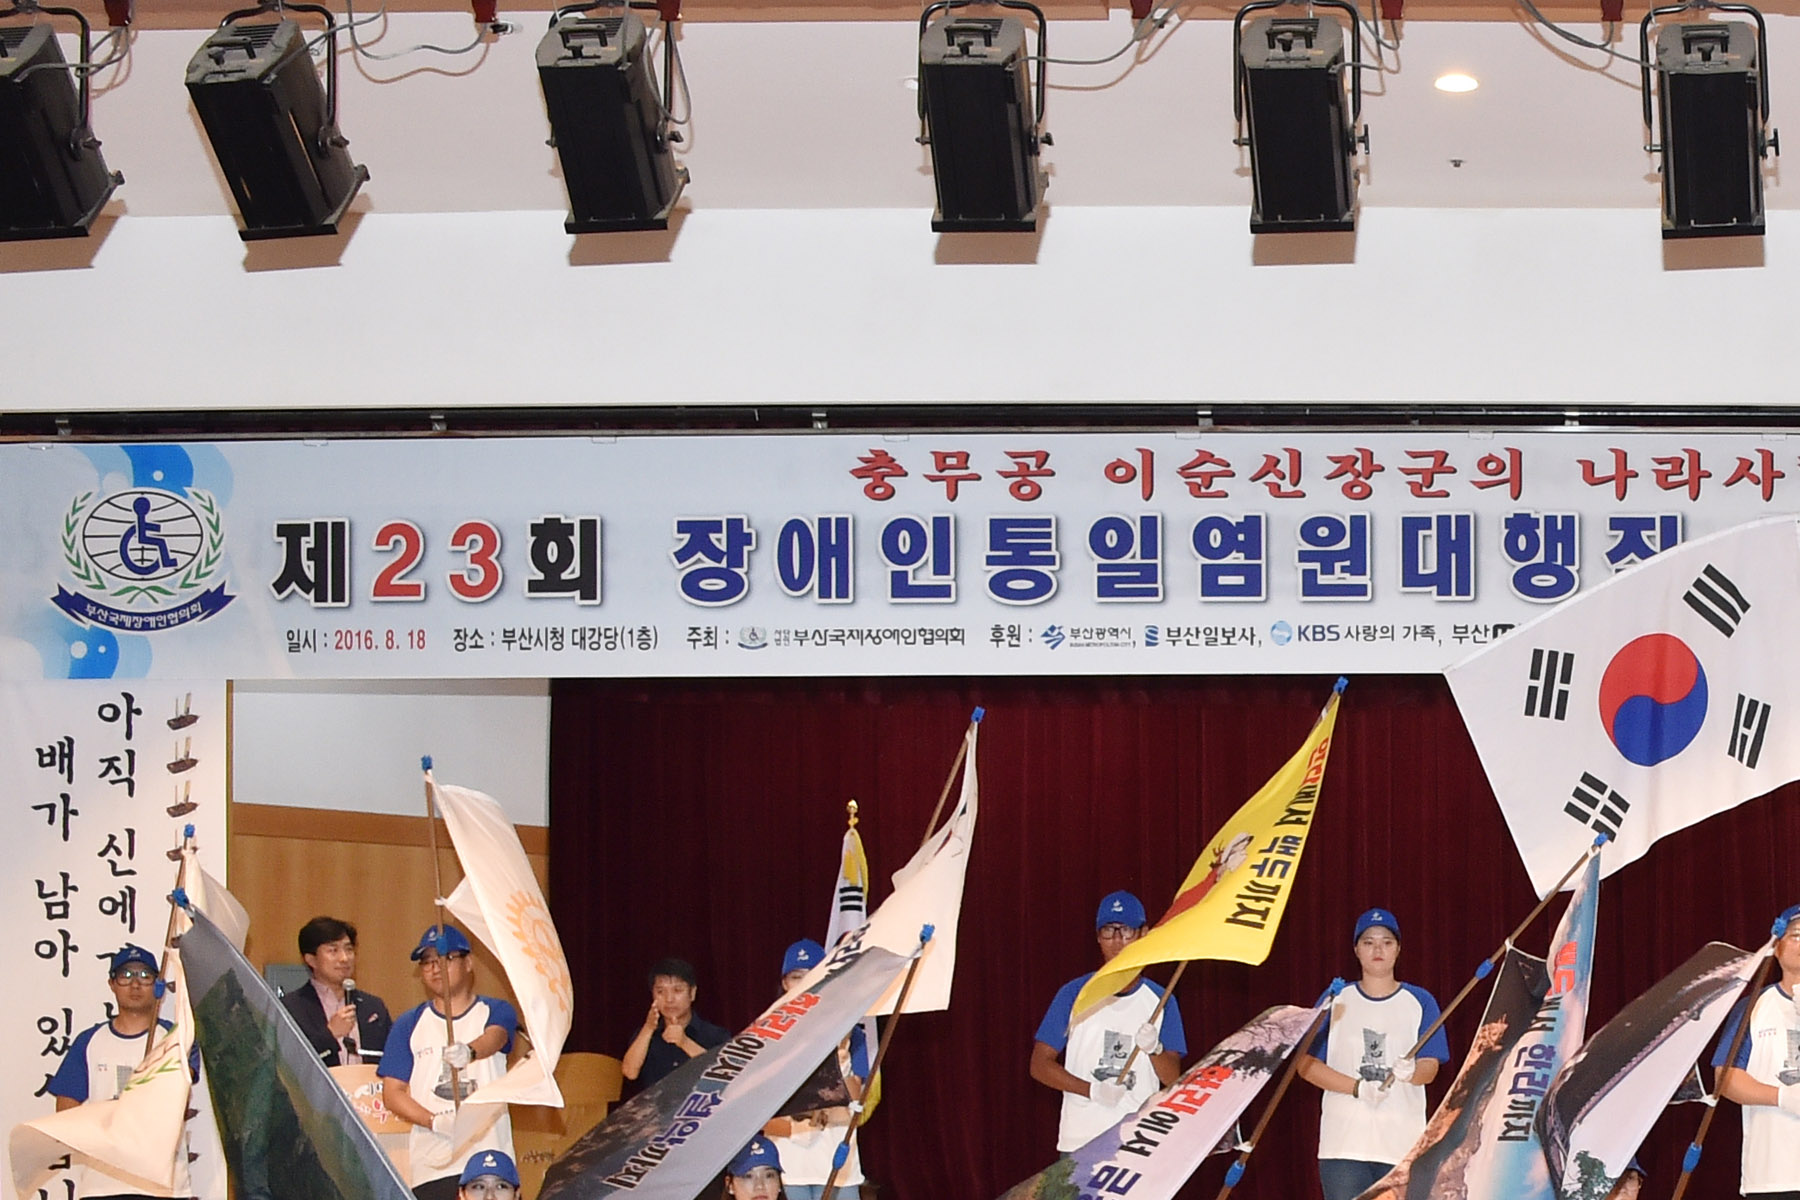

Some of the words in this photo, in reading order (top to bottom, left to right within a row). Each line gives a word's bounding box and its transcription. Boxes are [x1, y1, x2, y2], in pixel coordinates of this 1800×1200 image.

[849, 446, 1056, 501] 충무공
[1104, 447, 1524, 500] 이순신장군의
[273, 515, 604, 606] 제23회
[85, 601, 203, 629] 부산국제장애인협의회
[333, 629, 379, 651] 2016.
[385, 629, 400, 651] 8.
[407, 629, 427, 651] 18
[501, 626, 566, 652] 부산시청
[571, 624, 659, 652] 대강당(1층)
[793, 627, 966, 647] 부산국제장애인협의회
[1297, 624, 1341, 643] KBS
[1344, 624, 1395, 643] 사랑의
[32, 735, 81, 842] 배가
[97, 692, 142, 798] 아직
[34, 871, 80, 978] 남아
[1224, 834, 1303, 931] 백두까지
[606, 1083, 724, 1192] 설악까지
[1118, 1064, 1234, 1158] 한라에서
[1496, 1043, 1557, 1142] 한라까지
